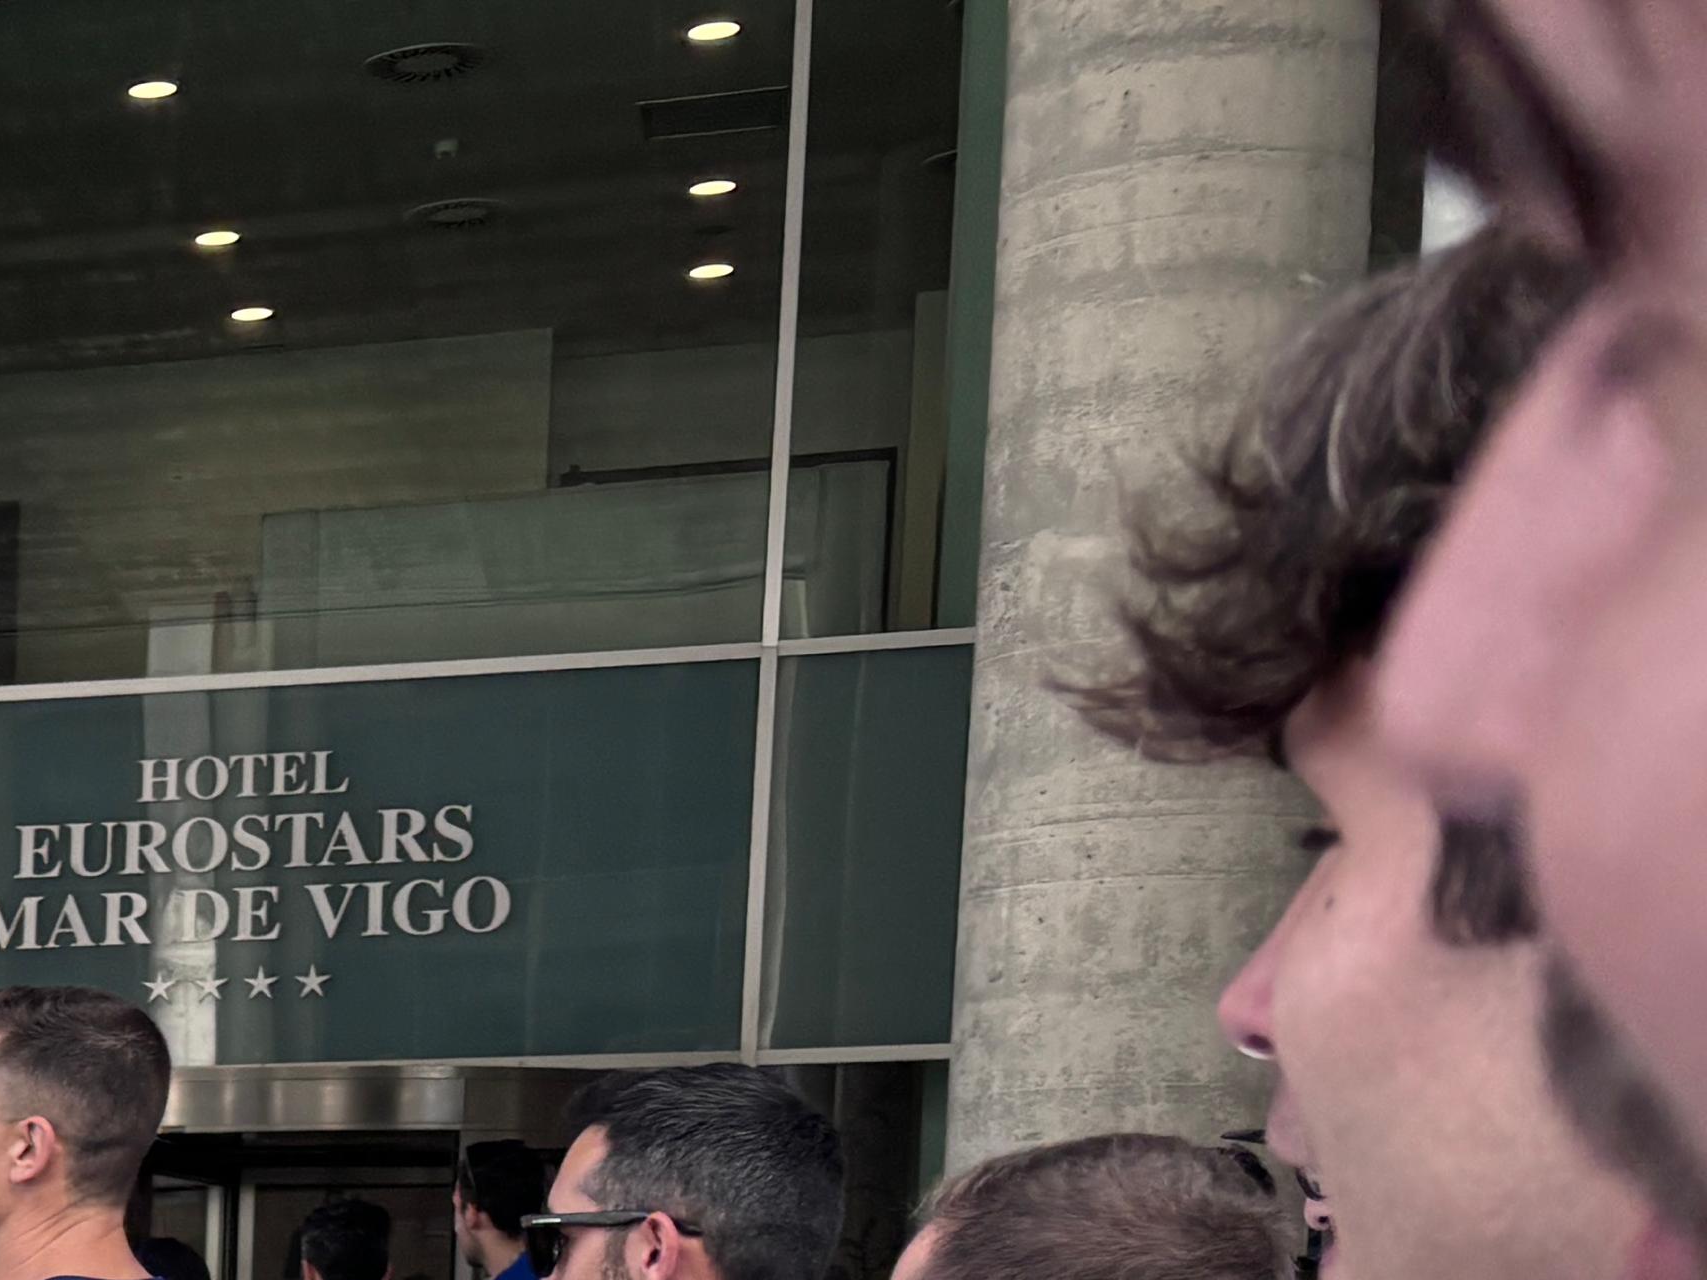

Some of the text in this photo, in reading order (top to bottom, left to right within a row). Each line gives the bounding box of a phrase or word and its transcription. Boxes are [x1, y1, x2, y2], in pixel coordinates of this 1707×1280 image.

[137, 750, 350, 803] HOTEL
[13, 804, 476, 880] EUROSTARS
[180, 885, 281, 943] DE
[304, 876, 512, 939] VIGO
